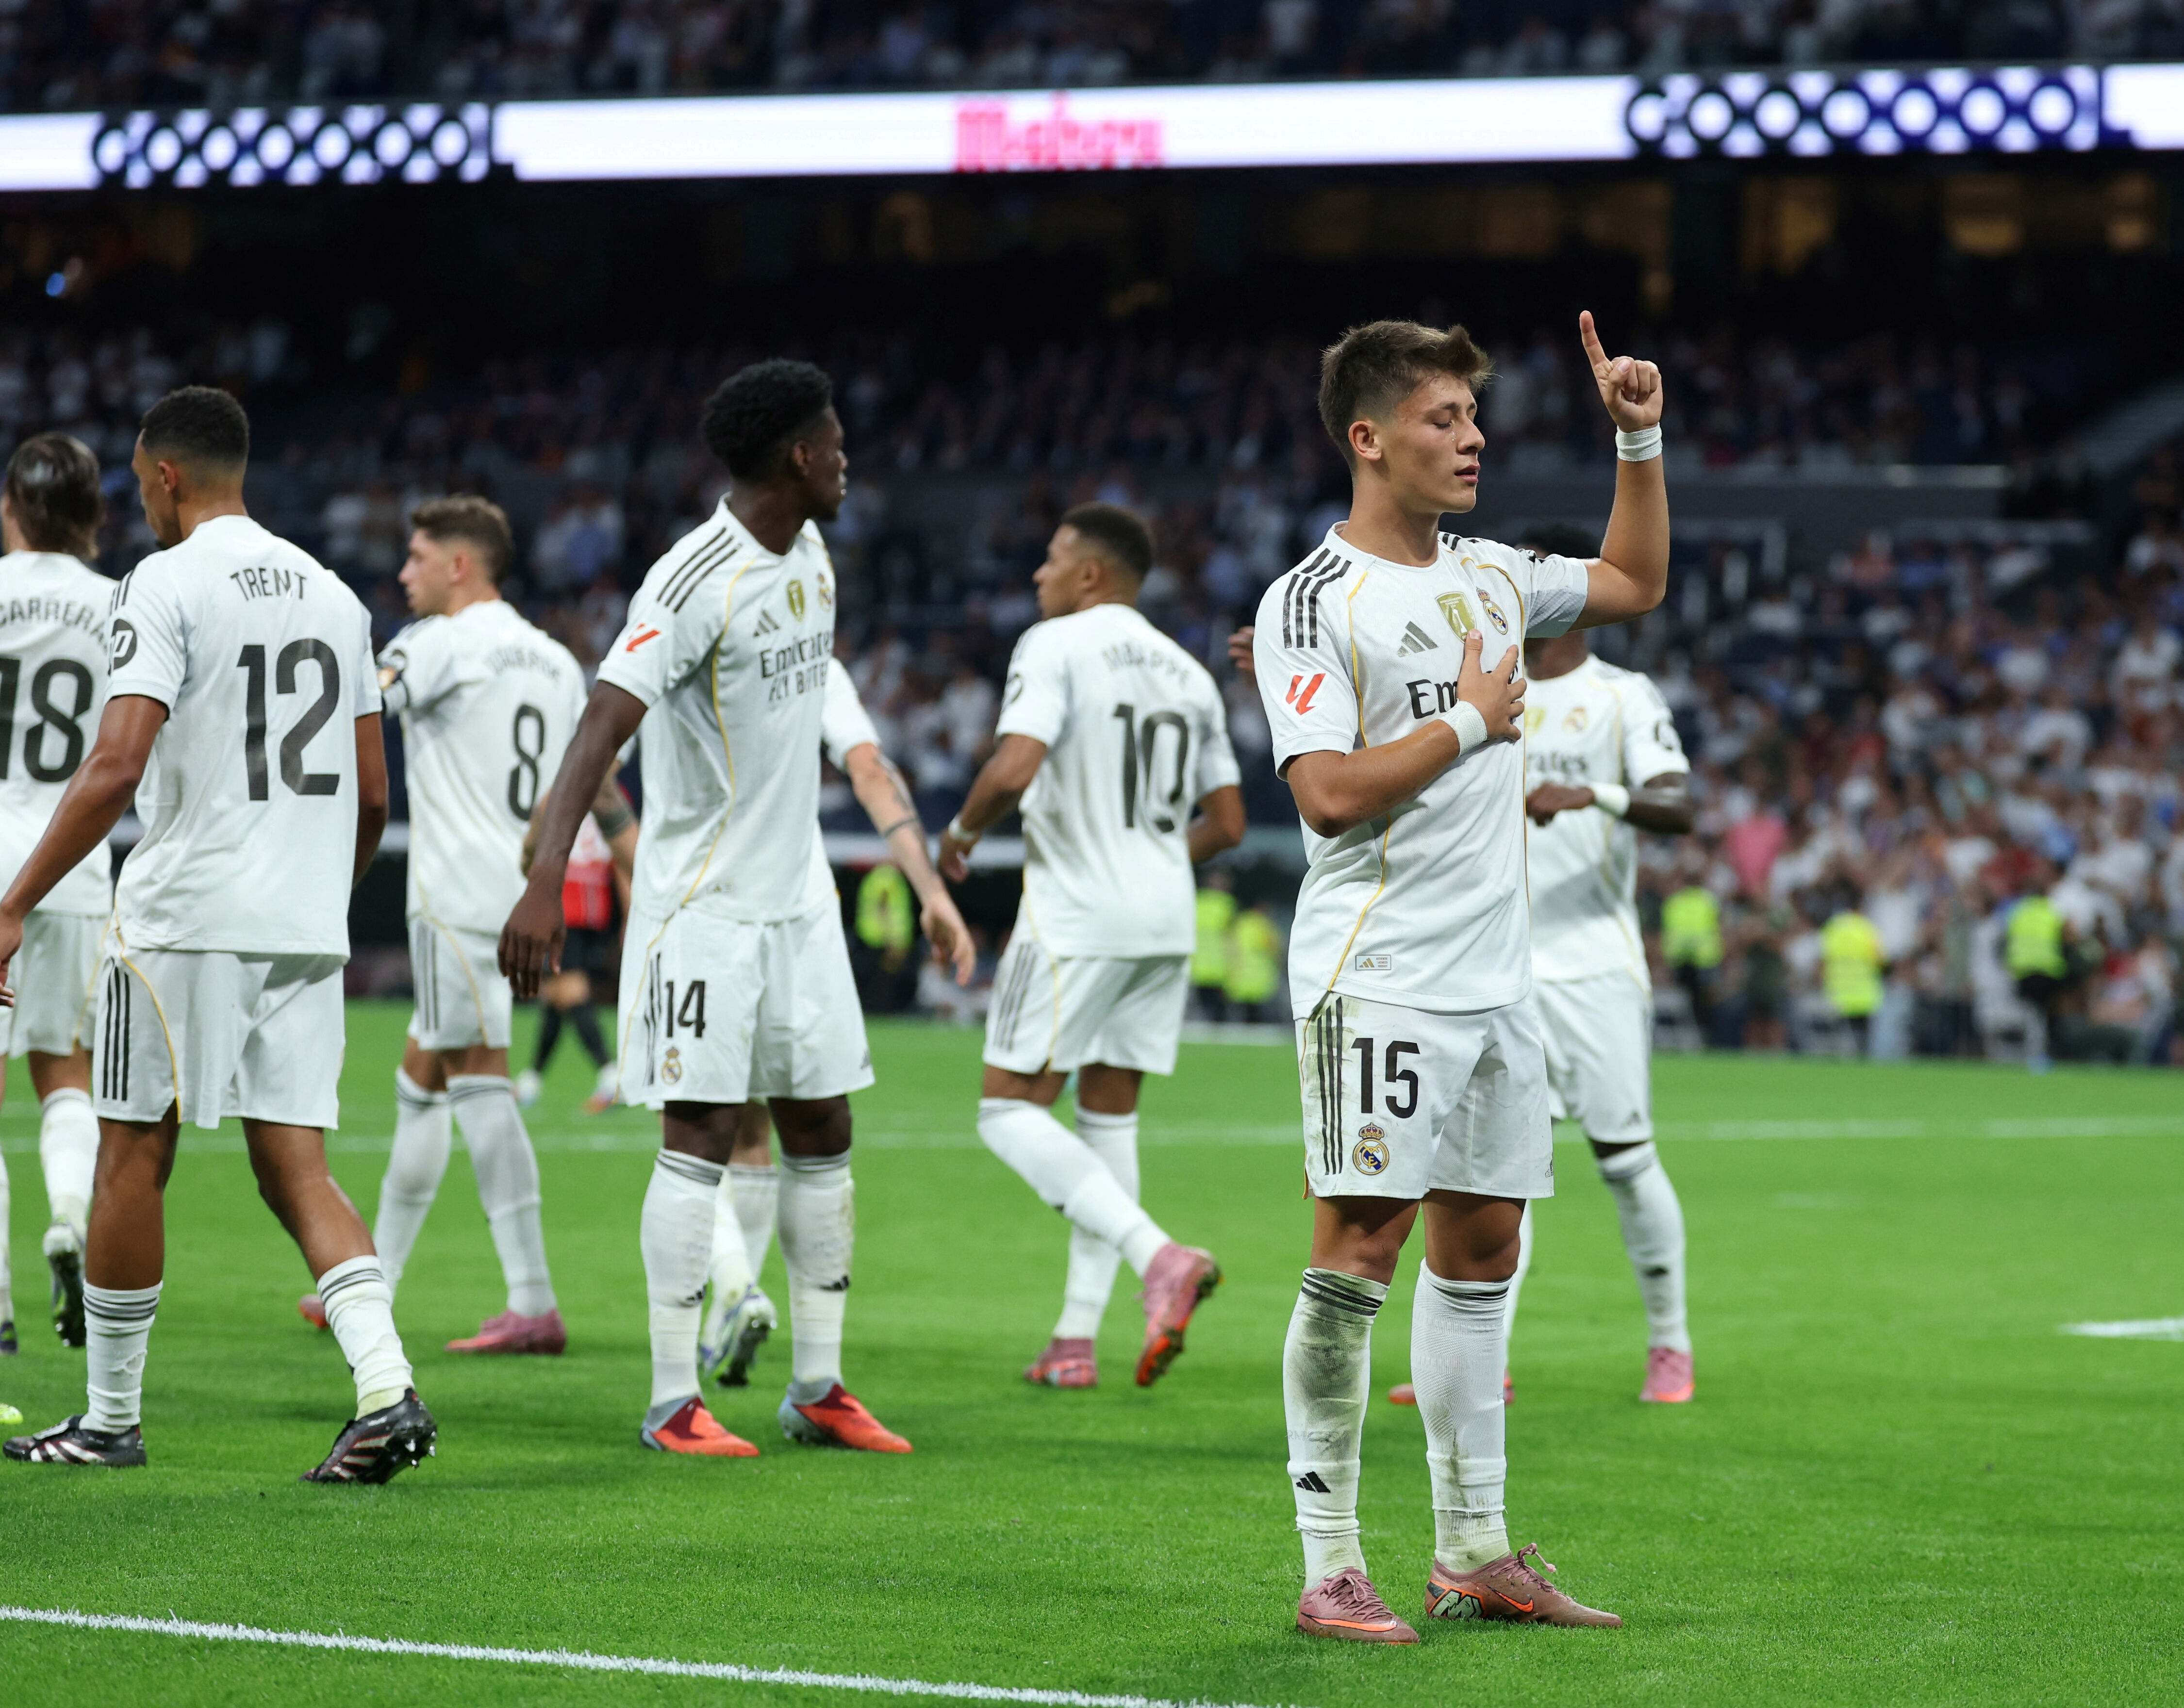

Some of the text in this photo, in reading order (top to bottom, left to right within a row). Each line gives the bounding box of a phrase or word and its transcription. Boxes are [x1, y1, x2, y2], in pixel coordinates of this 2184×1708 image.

[230, 567, 307, 602] TRENT
[0, 598, 108, 654] CARRERA
[761, 631, 834, 679] Emirate
[0, 657, 93, 782] 18
[236, 638, 340, 801] 12
[508, 704, 544, 821] 8
[1114, 703, 1189, 833] 10
[665, 981, 706, 1038] 14
[1351, 1037, 1420, 1119] 15
